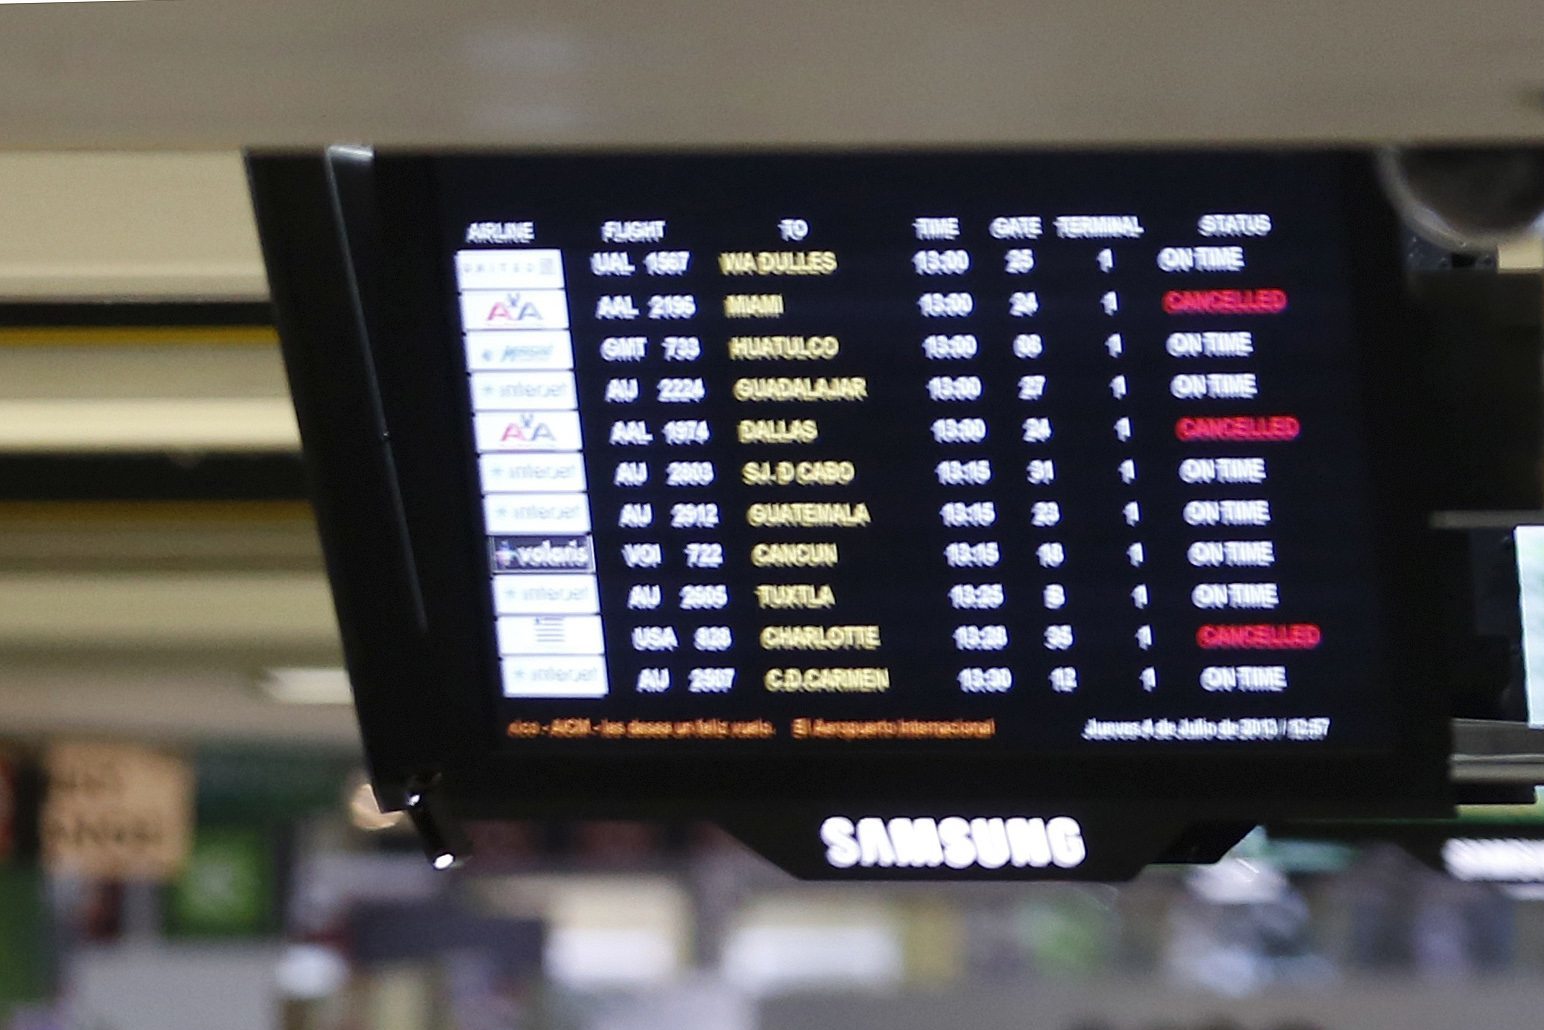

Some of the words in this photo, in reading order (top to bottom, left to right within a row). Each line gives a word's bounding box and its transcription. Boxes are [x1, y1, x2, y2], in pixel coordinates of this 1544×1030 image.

[464, 221, 535, 243] AIRLINE
[601, 220, 666, 243] FLIGHT
[778, 219, 808, 241] TO
[912, 217, 960, 240] TIME
[989, 216, 1043, 239] GATE
[1053, 215, 1144, 239] TERMINAL
[1198, 214, 1271, 237] STATUS
[590, 252, 635, 276] UAL
[757, 251, 838, 275] DULLES
[912, 250, 969, 275] 13:00
[1097, 249, 1113, 272] 1
[1157, 247, 1193, 272] ON
[1194, 246, 1245, 271] TIME
[595, 295, 640, 319] AAL
[724, 295, 783, 317] MIAMI
[917, 293, 976, 317] 13:00
[1009, 292, 1039, 317] 24
[1100, 291, 1118, 315] 1
[1164, 289, 1286, 313] CANCELLED
[600, 337, 648, 362] GMT
[729, 336, 839, 359] HUATULCO
[922, 335, 977, 359] 13:00
[1105, 333, 1122, 357] 1
[1166, 333, 1202, 357] ON
[1203, 332, 1254, 356] TIME
[657, 378, 705, 403] 2224
[926, 376, 982, 401] 13:00
[1110, 375, 1126, 399] 1
[1171, 374, 1207, 399] ON
[1208, 373, 1258, 398] TIME
[609, 421, 653, 445] AAL
[738, 420, 817, 443] DALLAS
[931, 418, 988, 443] 13:00
[1022, 418, 1052, 442] 24
[1114, 417, 1131, 441] 1
[1177, 416, 1299, 440] CANCELLED
[796, 461, 855, 485] CABO
[935, 460, 991, 485] 13:15
[1027, 460, 1054, 484] 31
[1118, 459, 1135, 484] 1
[1179, 459, 1215, 483] ON
[1216, 458, 1266, 482] TIME
[748, 503, 870, 526] GUATEMALA
[939, 502, 996, 527] 13:15
[1123, 501, 1139, 526] 1
[1183, 501, 1219, 525] ON
[1220, 500, 1271, 524] TIME
[516, 540, 589, 567] volaris
[621, 543, 664, 568] VOI
[683, 543, 723, 568] 722
[752, 544, 837, 566] CANCUN
[944, 542, 1000, 567] 13:15
[1127, 542, 1143, 567] 1
[1188, 542, 1224, 567] ON
[1225, 541, 1275, 566] TIME
[755, 585, 835, 608] TUXTLA
[1131, 584, 1148, 609] 1
[1192, 584, 1228, 609] ON
[1229, 583, 1279, 608] TIME
[631, 626, 678, 651] USA
[761, 626, 880, 649] CHARLOTTE
[1135, 625, 1152, 650] 1
[1197, 624, 1320, 648] CANCELLED
[1139, 667, 1156, 691] 1
[1200, 667, 1236, 692] ON
[1237, 666, 1287, 691] TIME
[813, 717, 899, 741] Aeropuerto
[900, 717, 995, 738] Internacional
[819, 815, 1088, 870] SAMSUNG
